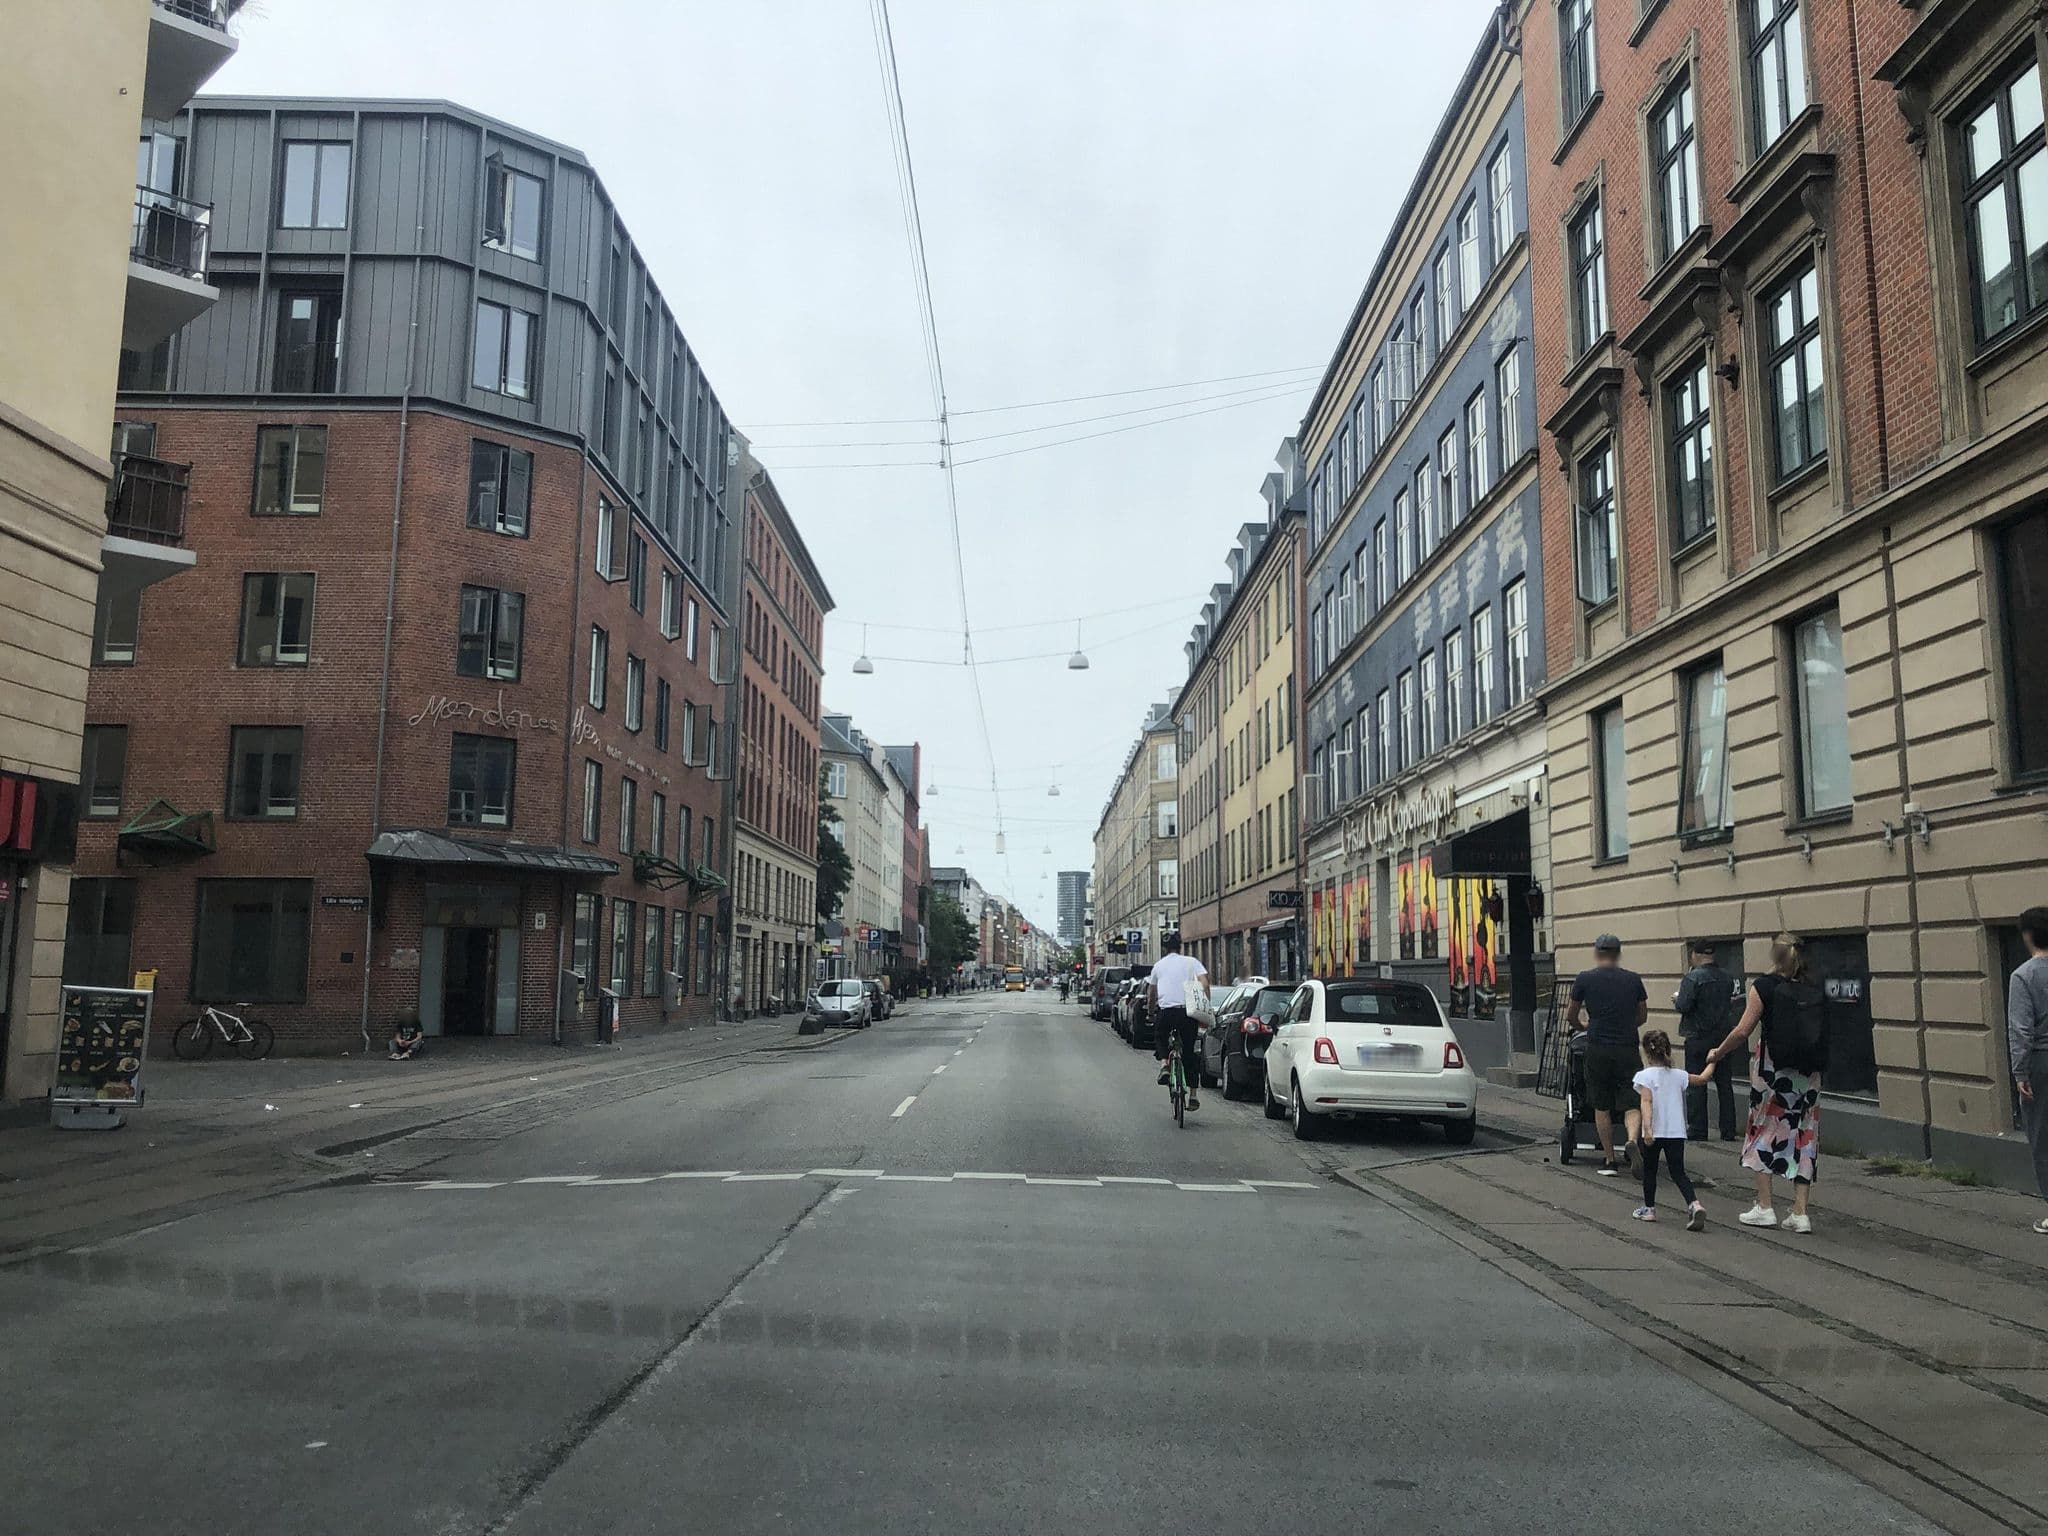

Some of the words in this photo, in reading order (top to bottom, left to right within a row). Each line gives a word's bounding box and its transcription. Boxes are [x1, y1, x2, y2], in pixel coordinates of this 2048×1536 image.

[1367, 802, 1388, 845] Club
[1388, 784, 1453, 848] Copenhagen
[1269, 891, 1304, 907] KIOK
